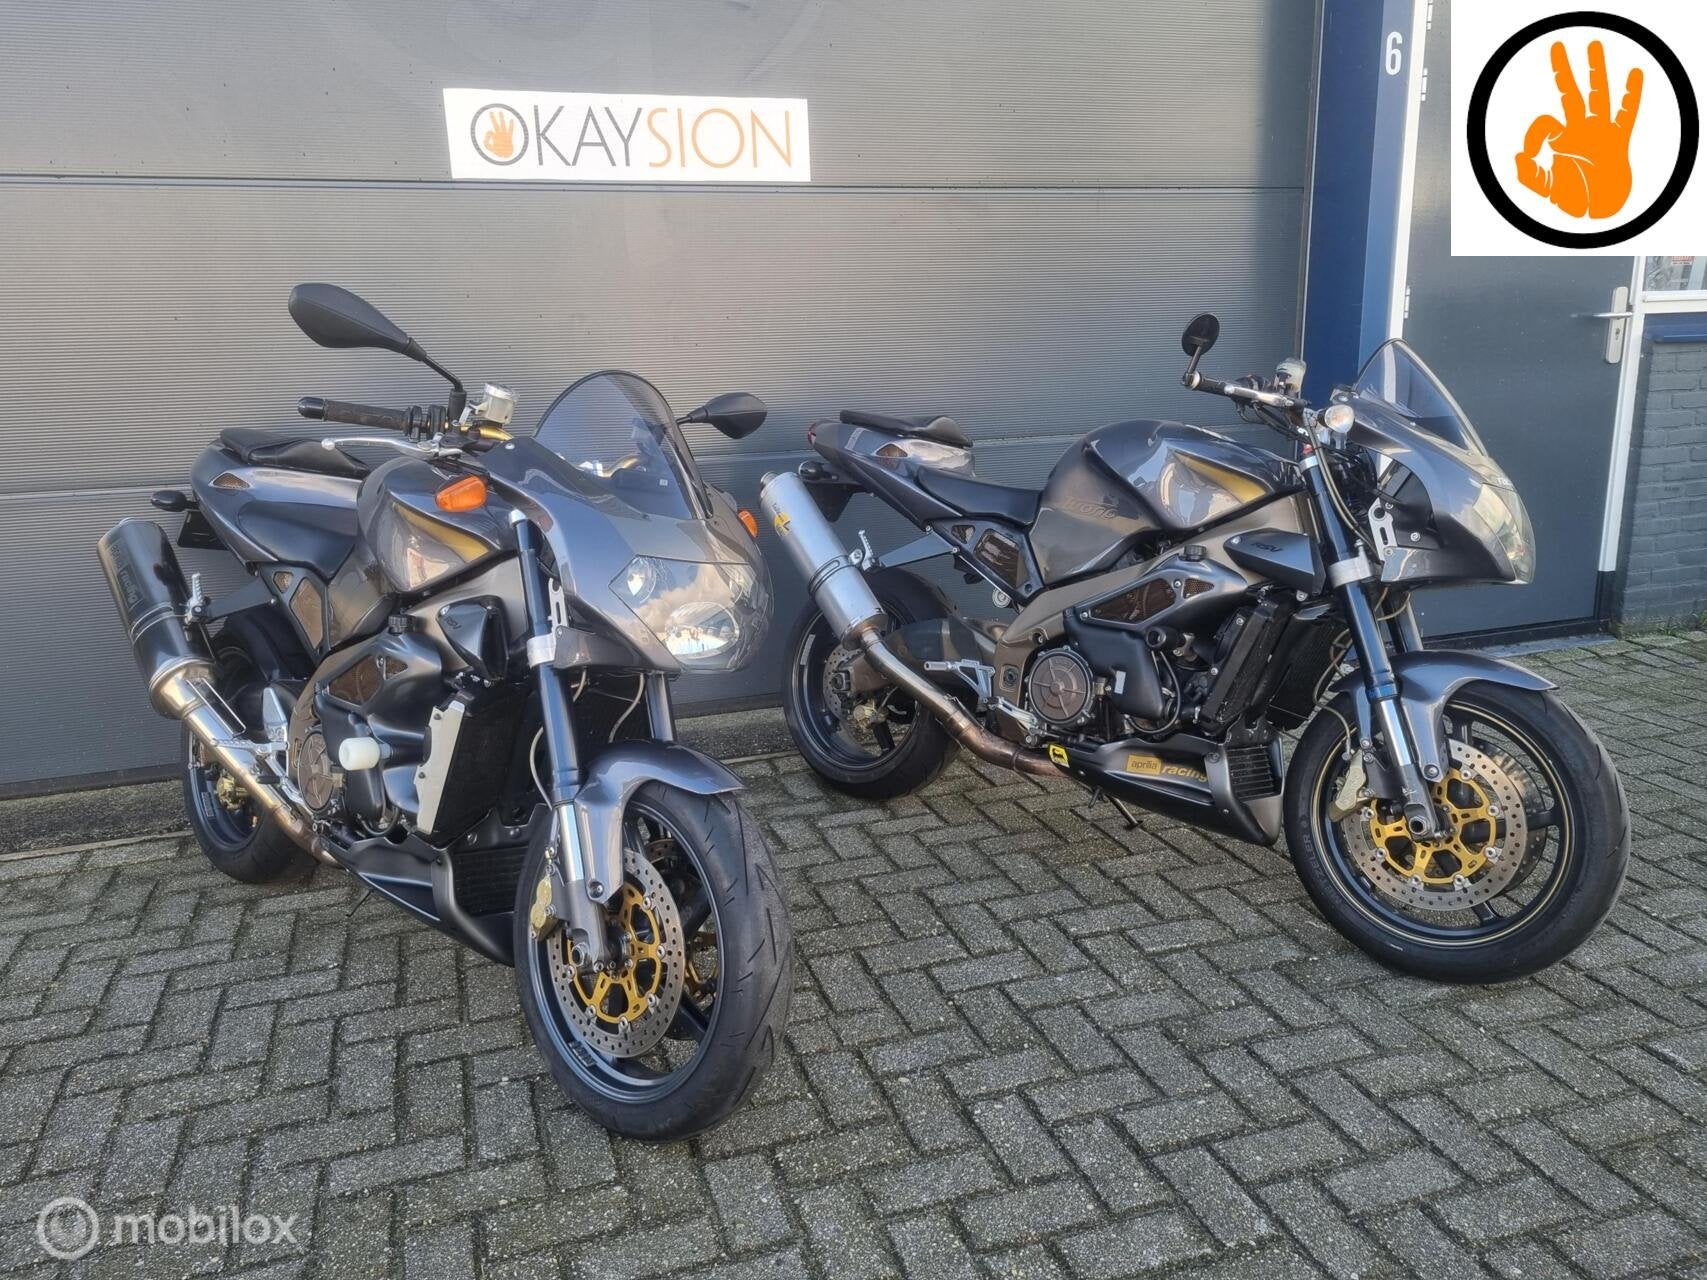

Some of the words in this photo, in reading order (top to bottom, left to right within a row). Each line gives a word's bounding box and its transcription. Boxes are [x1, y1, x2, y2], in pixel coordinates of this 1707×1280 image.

[1385, 31, 1403, 76] 6
[471, 103, 793, 169] OKAYSION
[1130, 760, 1158, 770] aprilia
[1161, 765, 1207, 783] racing
